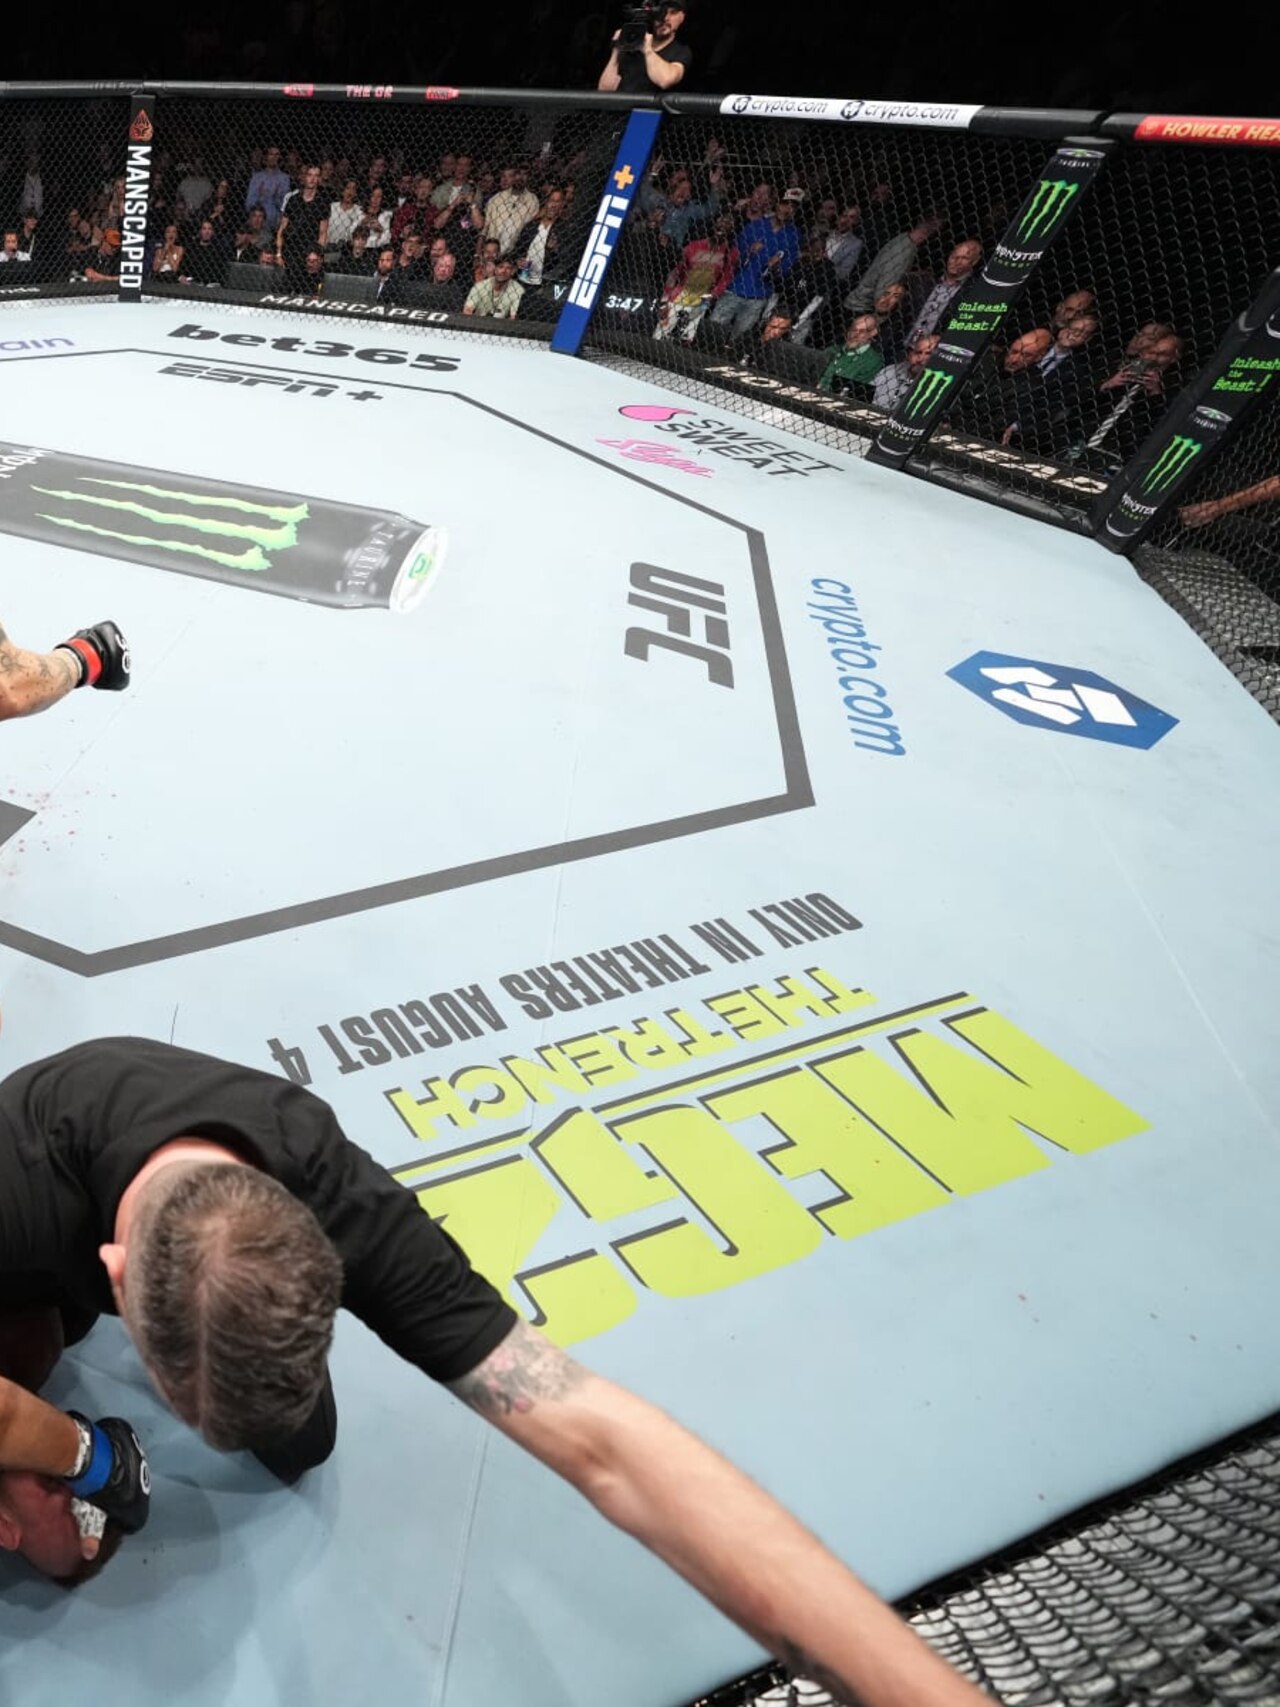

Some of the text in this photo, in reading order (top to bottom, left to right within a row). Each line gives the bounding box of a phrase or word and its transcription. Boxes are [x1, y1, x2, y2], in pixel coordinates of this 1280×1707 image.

[751, 100, 829, 114] crypto.com
[864, 103, 960, 121] crypto.com
[1162, 122, 1280, 141] HOWLER HEA
[120, 145, 152, 289] MANSCAPED
[567, 164, 635, 310] ESPN+
[261, 294, 448, 322] MANSCAPED
[605, 295, 644, 312] 3:47
[948, 315, 1002, 331] Beast!
[168, 324, 461, 372] bet365
[157, 362, 383, 402] ESPN+
[654, 424, 809, 477] SWEAT
[688, 418, 845, 472] SWEET
[624, 561, 735, 689] UFC
[806, 577, 907, 757] crypto.com
[267, 892, 863, 1085] ONLY IN THEATERS AUGUST 4
[383, 967, 878, 1140] THE TRENCH
